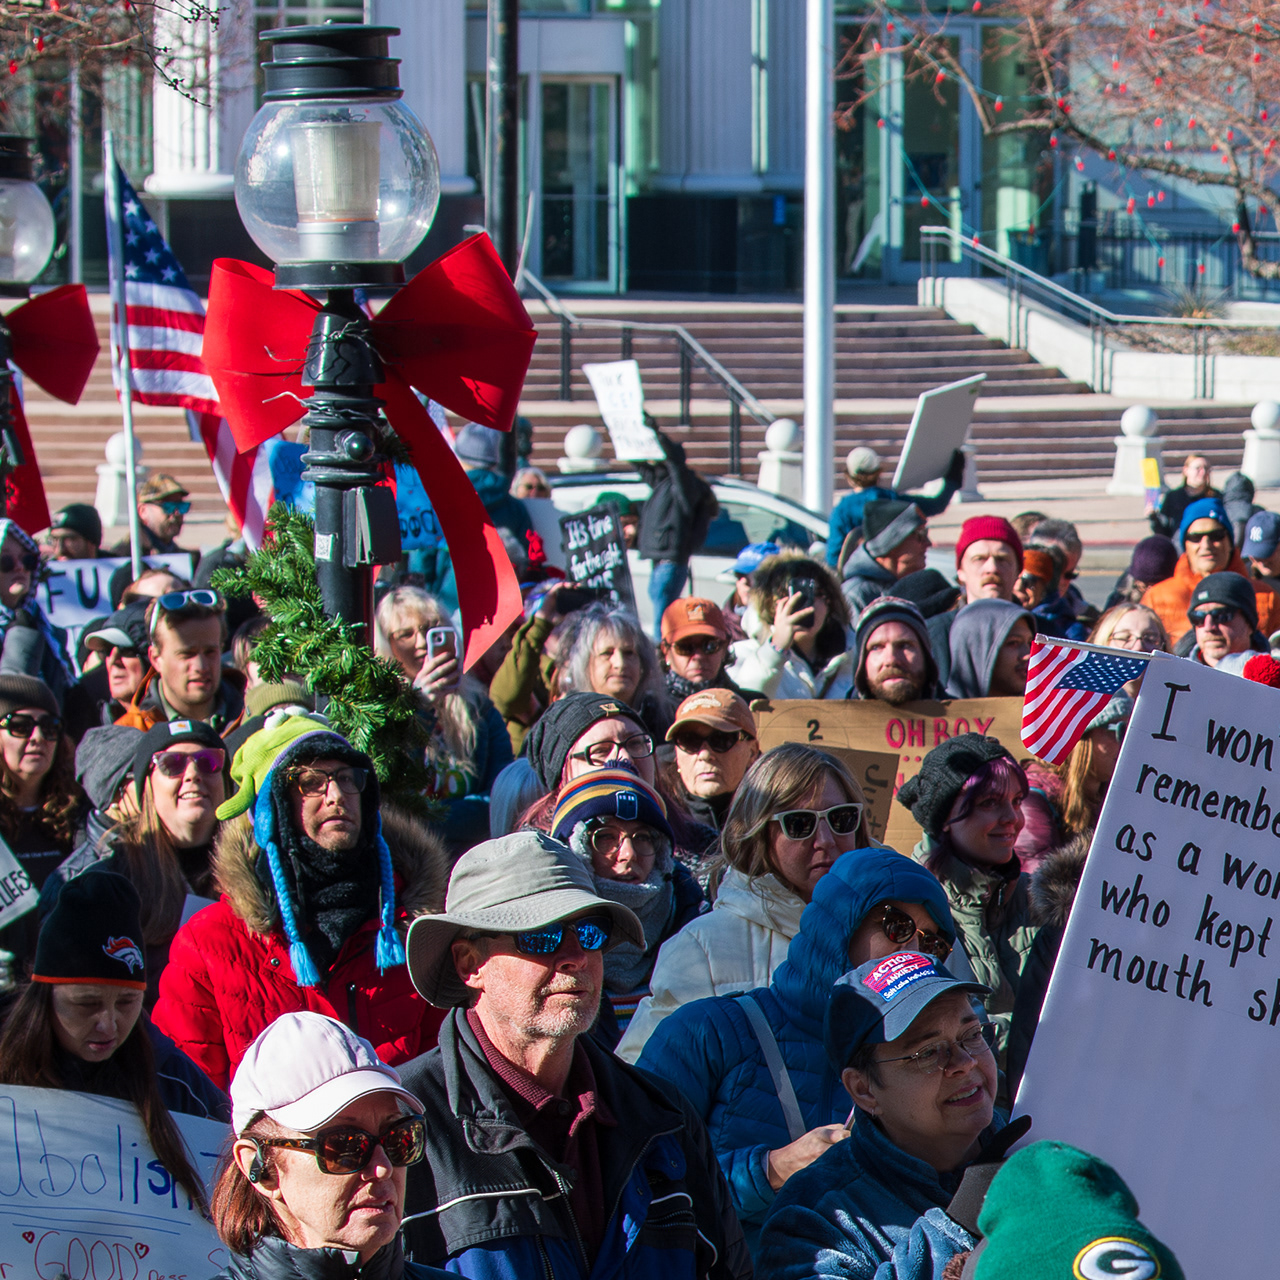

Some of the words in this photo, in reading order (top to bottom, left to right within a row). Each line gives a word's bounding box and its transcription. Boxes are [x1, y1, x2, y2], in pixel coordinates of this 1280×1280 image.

[806, 719, 823, 743] 2
[885, 718, 926, 749] OH
[1151, 682, 1192, 741] I
[1115, 824, 1157, 861] as
[1178, 842, 1203, 876] a
[0, 868, 32, 912] LIEFS
[1100, 874, 1170, 928] who
[1194, 894, 1273, 968] kept
[871, 954, 915, 981] ACTION
[883, 986, 898, 999] Salt
[896, 978, 910, 990] Lake
[886, 963, 920, 986] ANXIETY
[1087, 938, 1213, 1008] mouth
